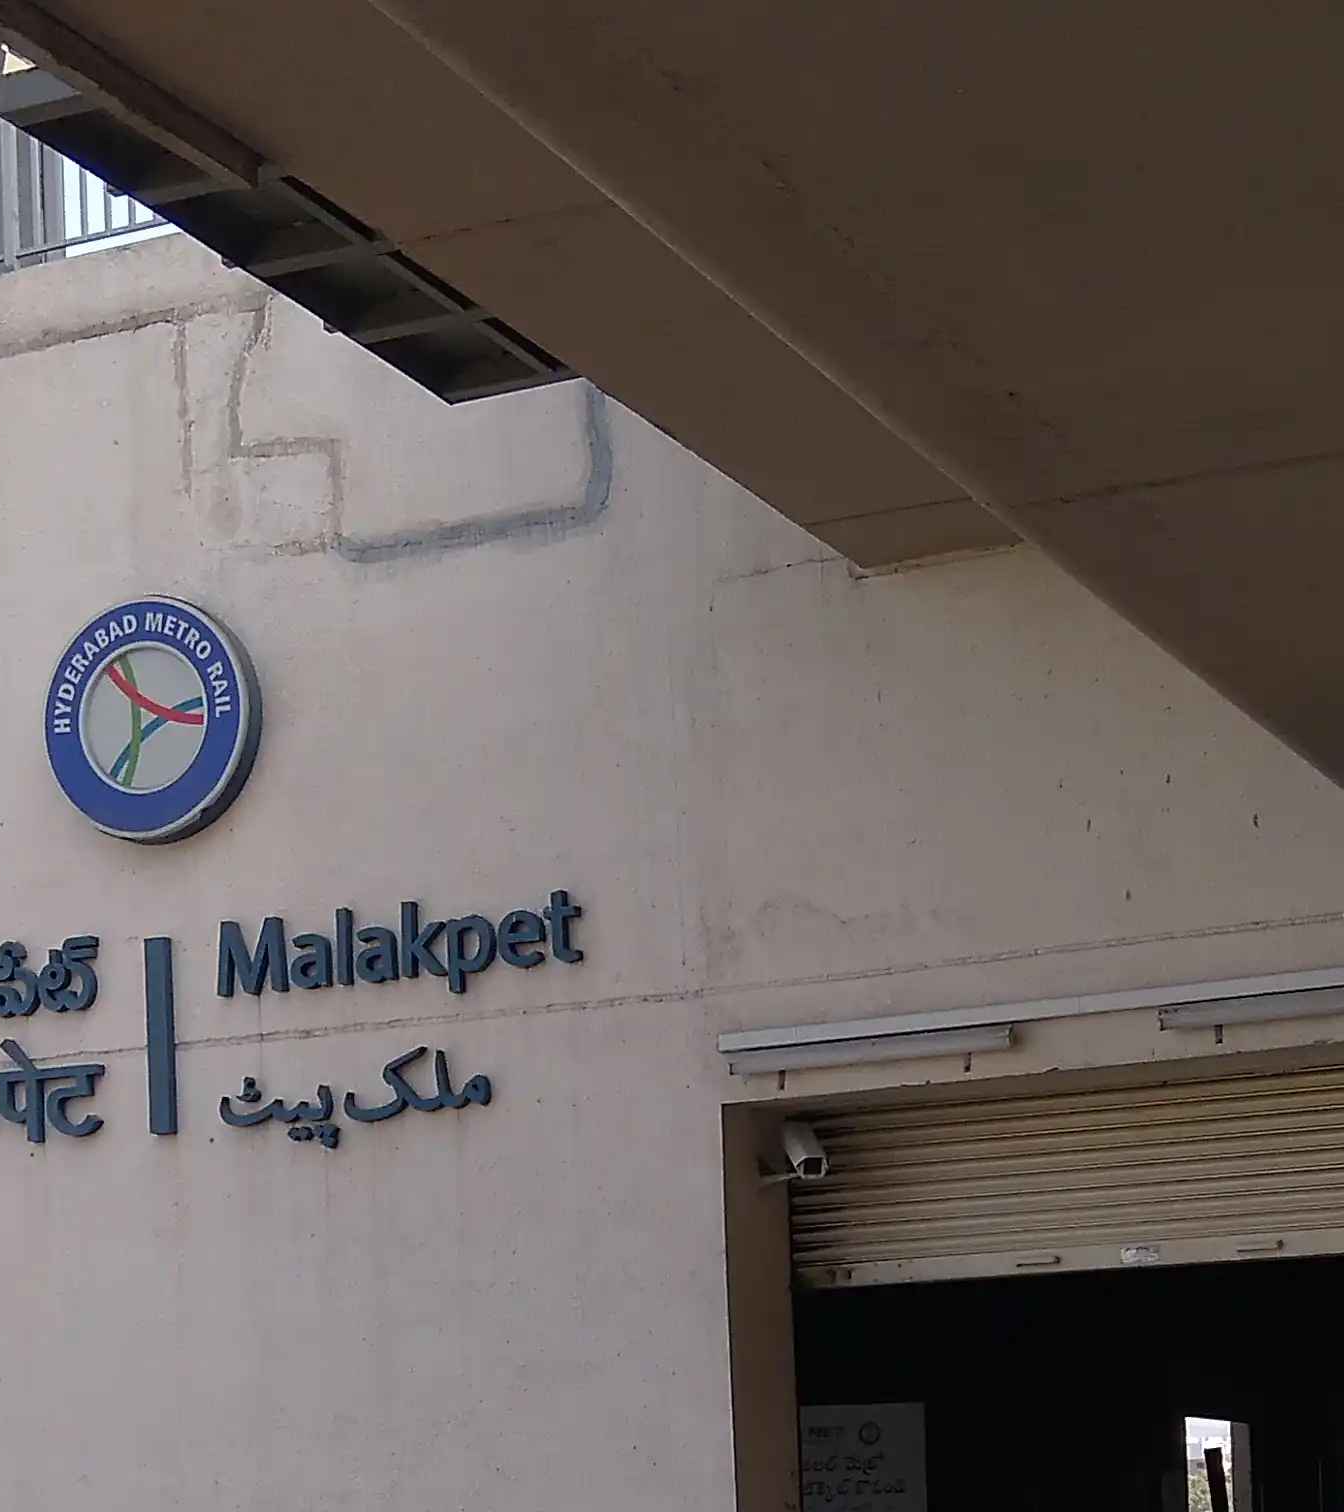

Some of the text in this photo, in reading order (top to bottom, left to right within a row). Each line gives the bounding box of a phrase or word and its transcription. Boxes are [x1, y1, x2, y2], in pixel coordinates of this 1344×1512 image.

[53, 611, 231, 734] HYDERABAD METRO RAIL
[216, 889, 585, 999] Malakpet
